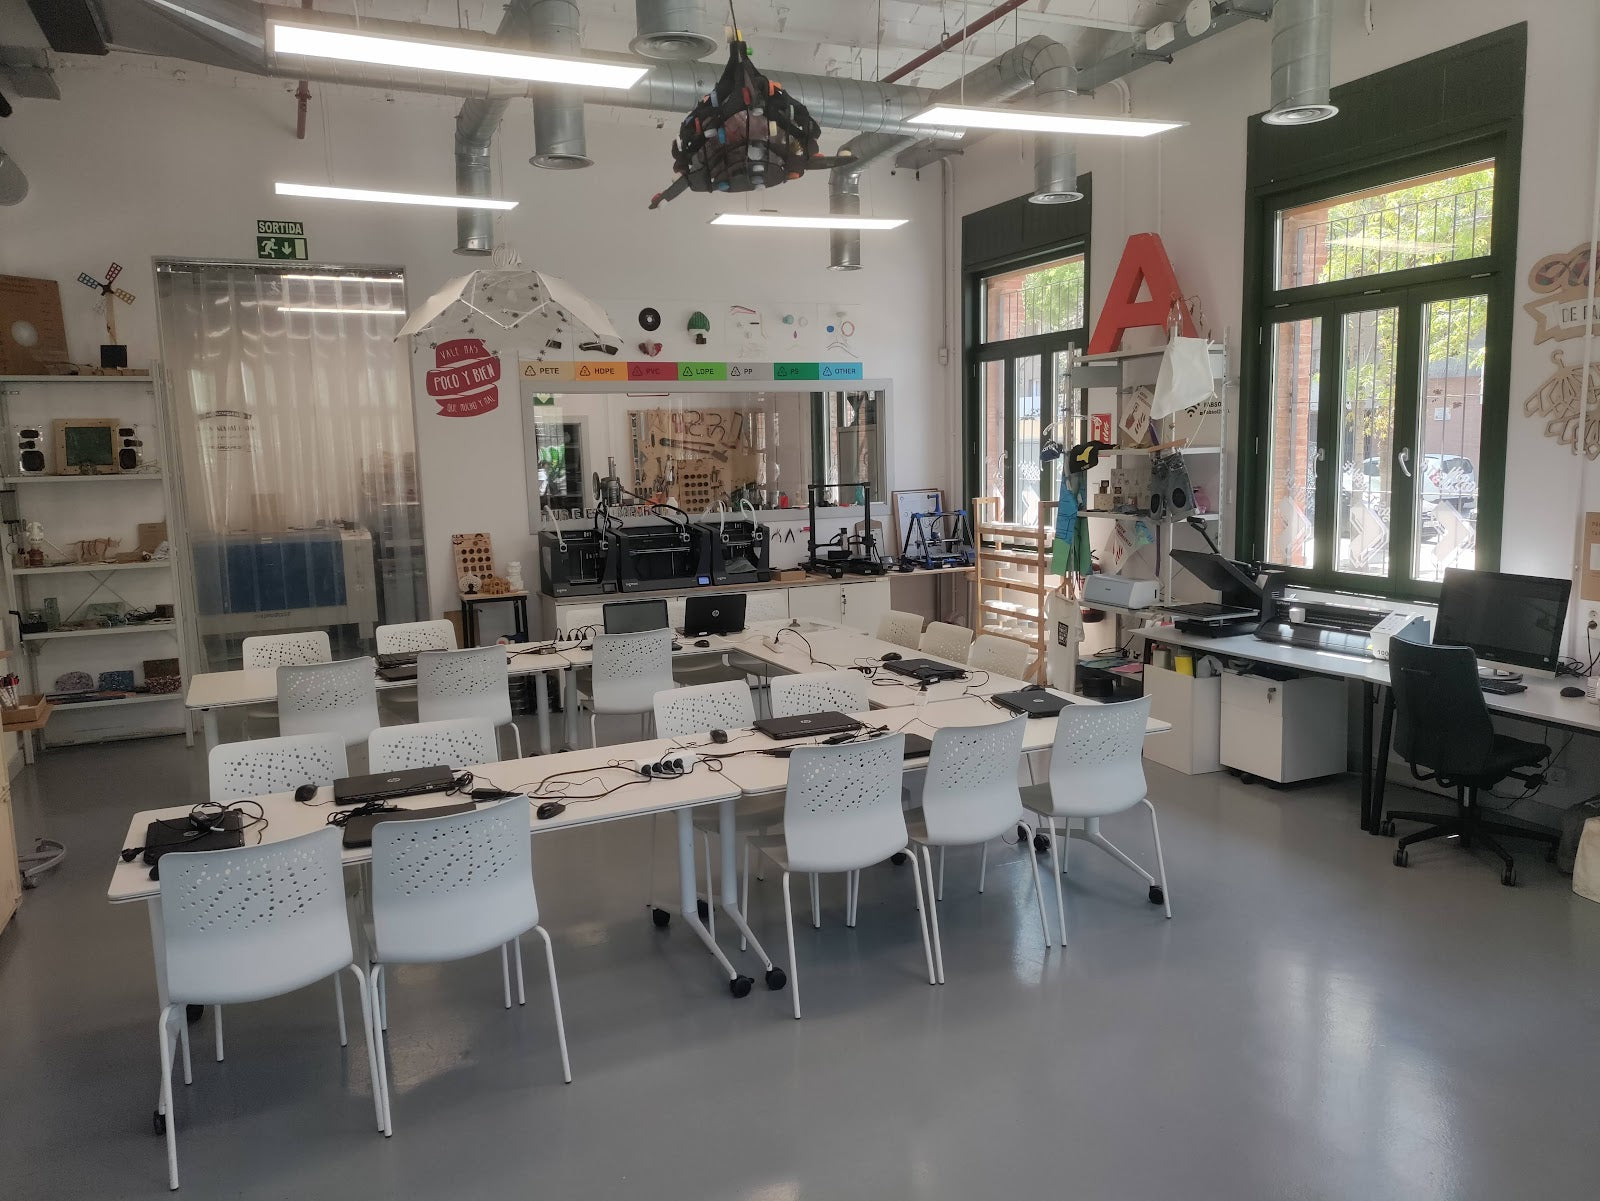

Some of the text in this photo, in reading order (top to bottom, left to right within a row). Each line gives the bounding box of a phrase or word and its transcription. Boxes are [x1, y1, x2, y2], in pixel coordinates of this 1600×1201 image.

[258, 221, 303, 235] SORTIDA
[1087, 232, 1199, 356] A
[539, 367, 560, 375] PETE
[594, 367, 615, 375] HDPE
[645, 367, 661, 375] PVC
[434, 363, 496, 391] POCO Y BIEN
